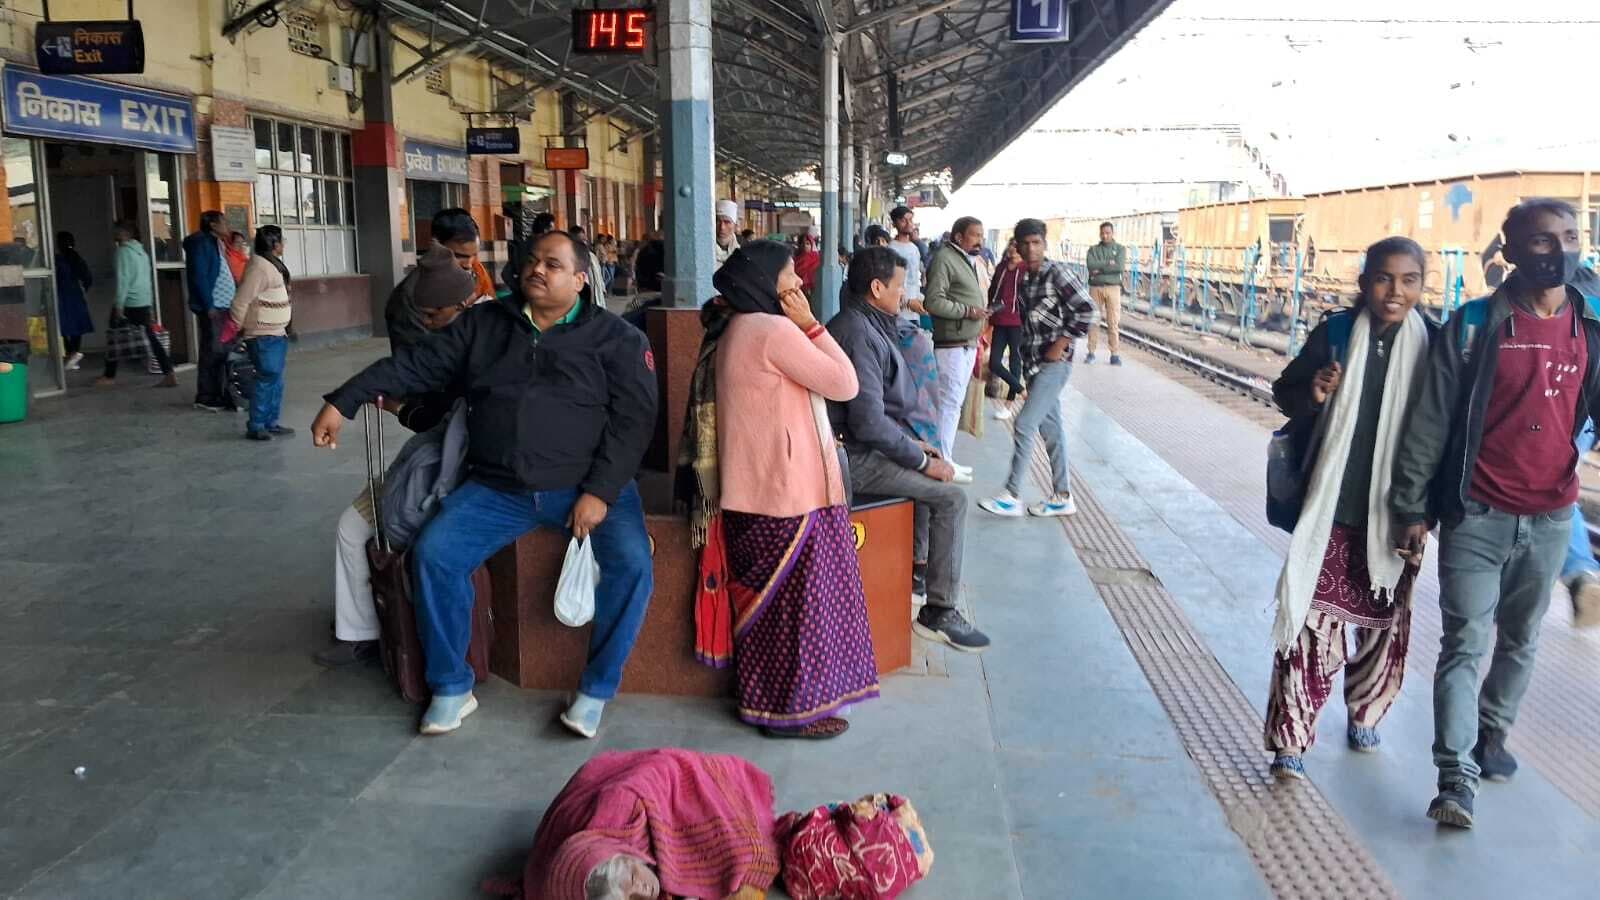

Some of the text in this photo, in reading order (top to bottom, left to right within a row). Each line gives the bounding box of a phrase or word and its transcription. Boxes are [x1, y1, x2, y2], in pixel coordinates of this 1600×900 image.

[1031, 0, 1049, 27] 1
[74, 28, 123, 46] निकास
[75, 50, 104, 63] Exit
[16, 82, 187, 137] निकास EXIT
